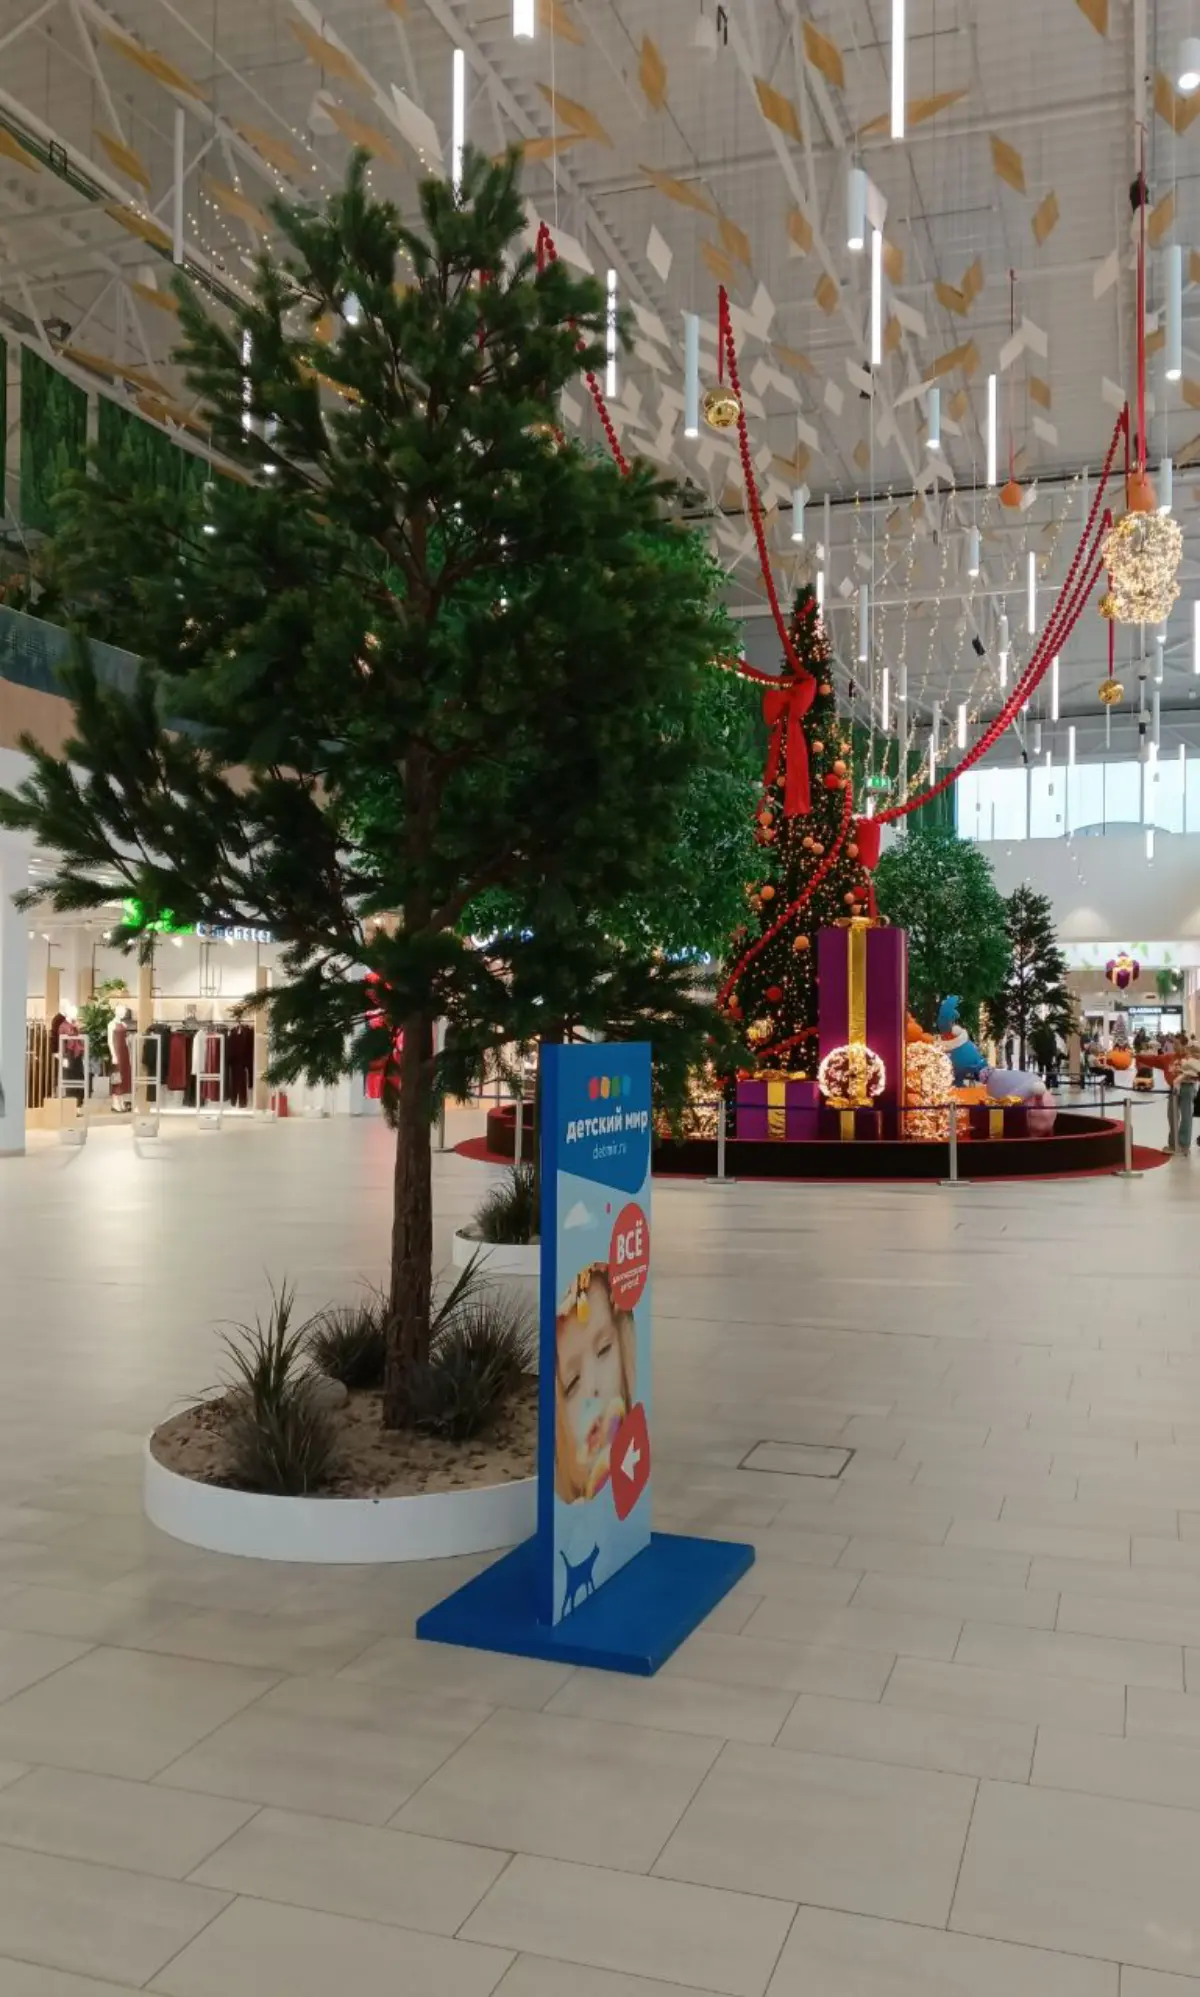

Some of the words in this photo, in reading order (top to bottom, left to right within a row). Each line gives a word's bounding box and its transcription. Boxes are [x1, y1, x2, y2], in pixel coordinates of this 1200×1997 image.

[566, 1106, 622, 1144] детский
[625, 1111, 648, 1134] мир
[616, 1218, 643, 1265] ВСЁ
